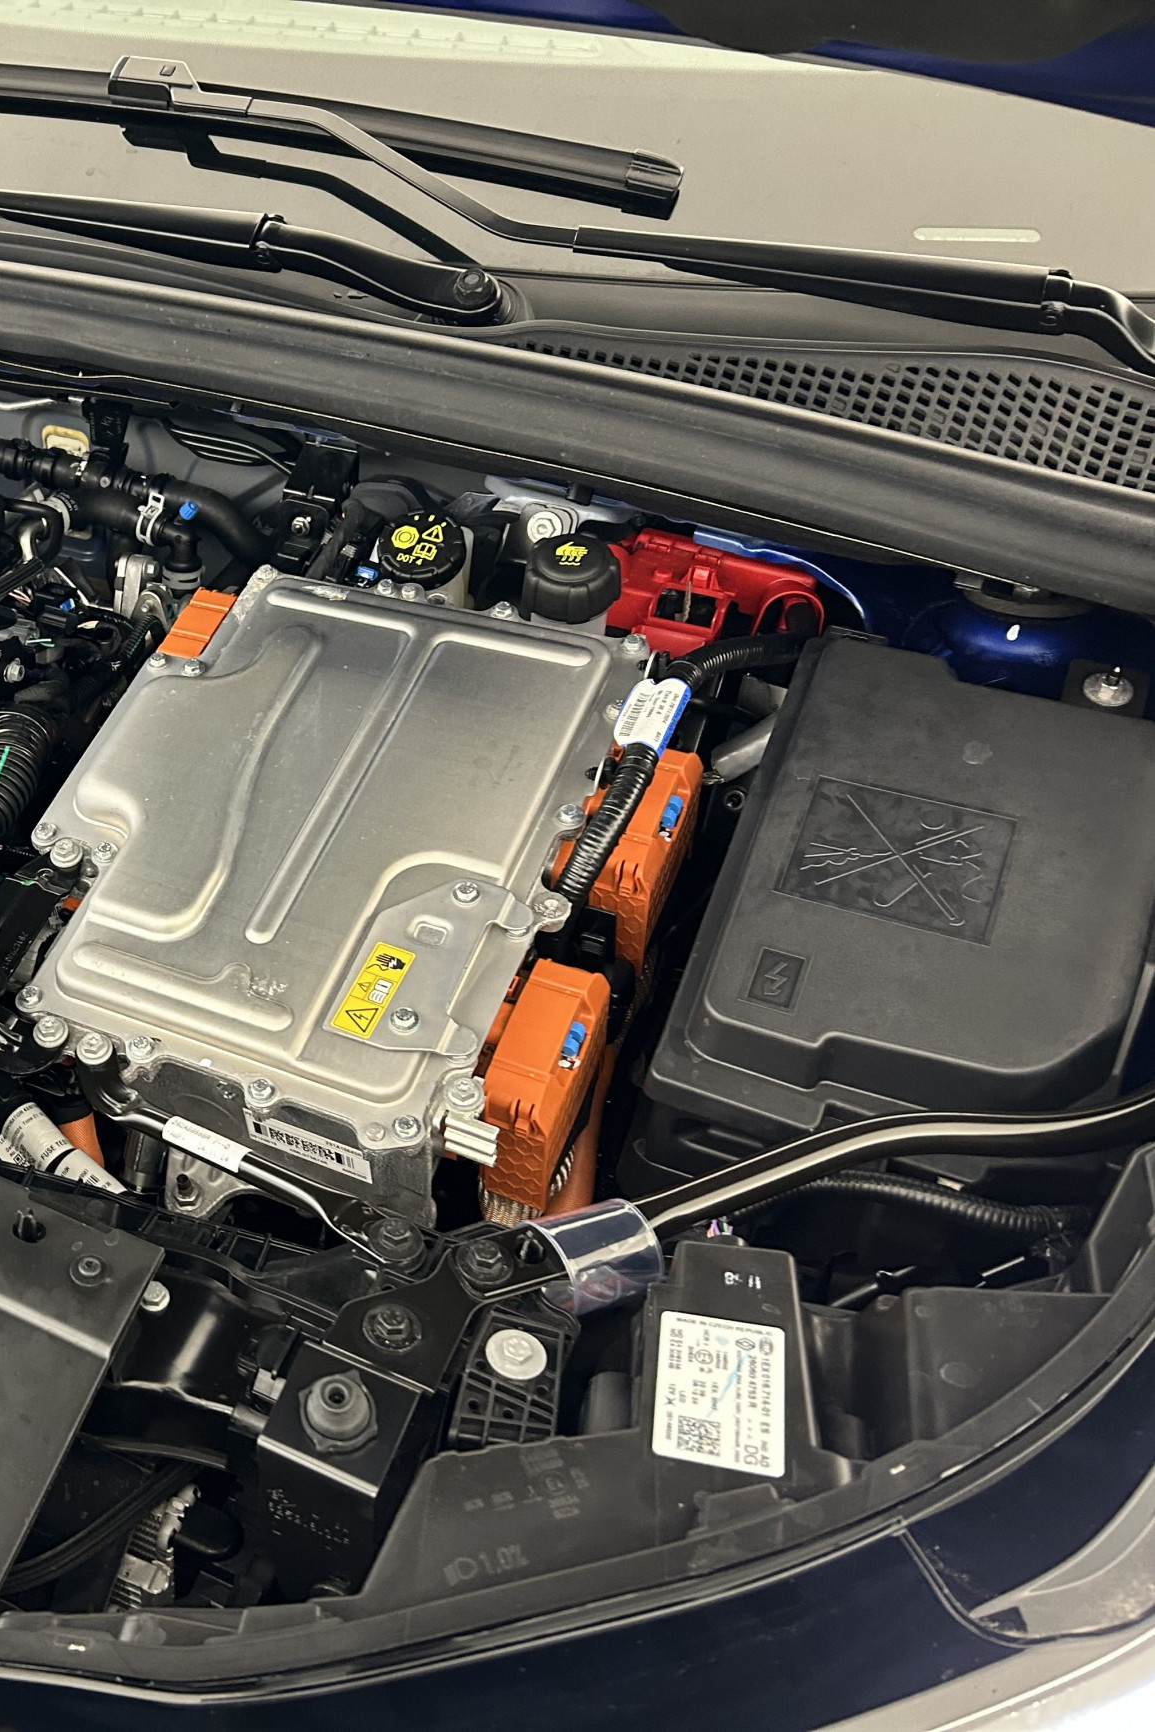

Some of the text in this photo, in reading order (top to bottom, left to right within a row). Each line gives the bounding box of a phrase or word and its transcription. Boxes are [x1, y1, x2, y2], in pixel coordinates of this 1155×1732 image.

[396, 553, 424, 566] DOT 4
[40, 1145, 56, 1160] FUSE
[676, 1316, 696, 1324] MADE
[743, 1443, 758, 1466] DG
